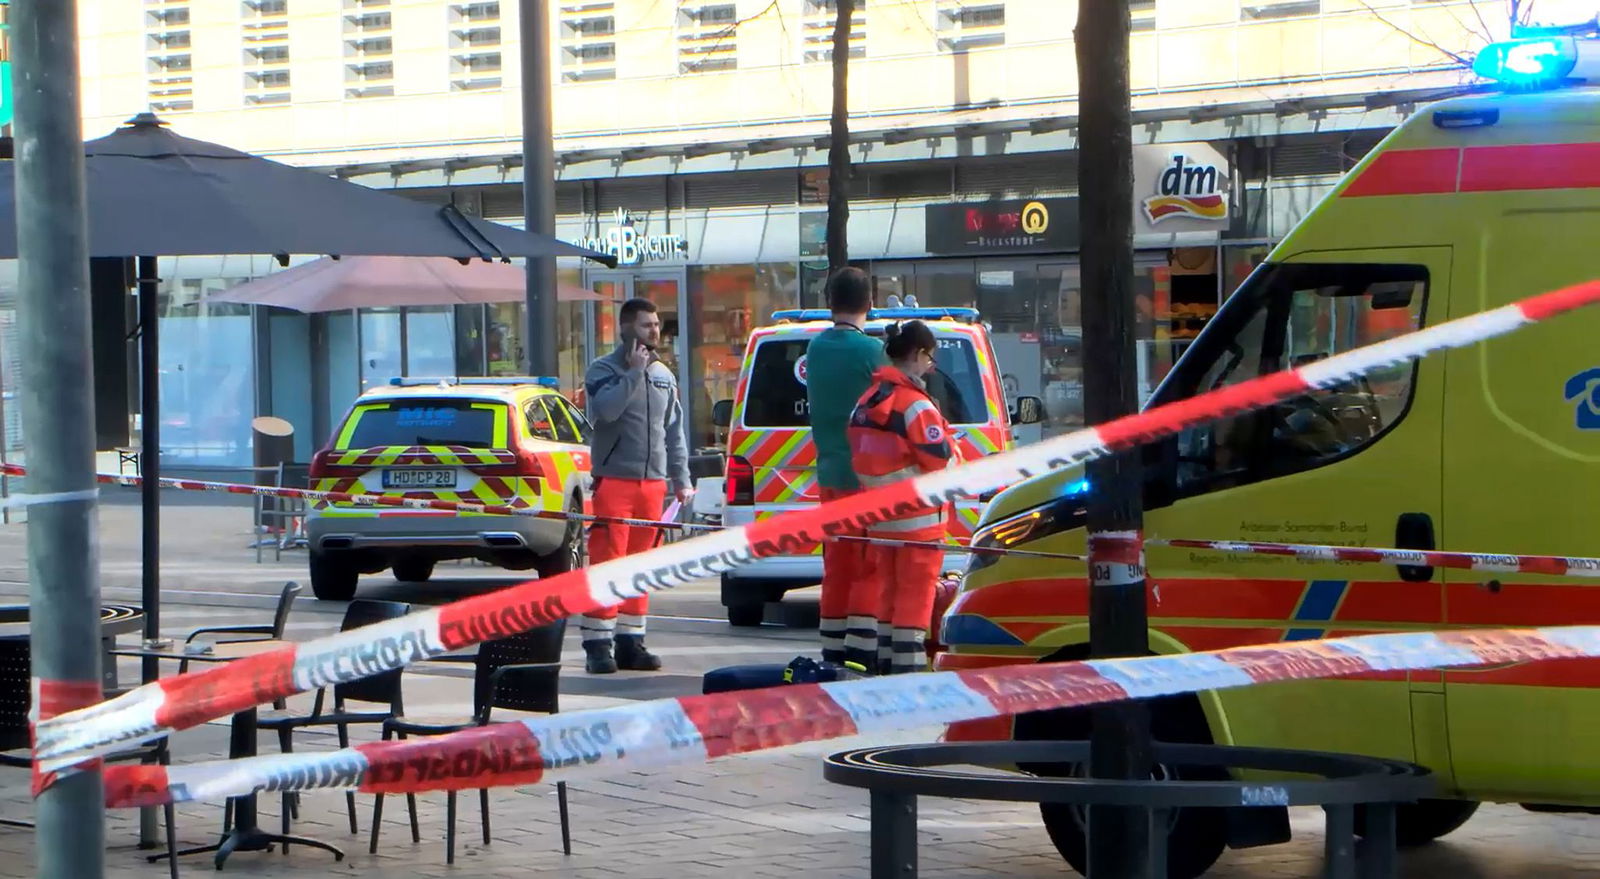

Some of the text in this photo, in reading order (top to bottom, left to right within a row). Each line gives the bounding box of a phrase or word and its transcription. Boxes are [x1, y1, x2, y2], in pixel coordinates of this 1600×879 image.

[1160, 154, 1217, 196] dm
[393, 471, 450, 484] HD CP 28
